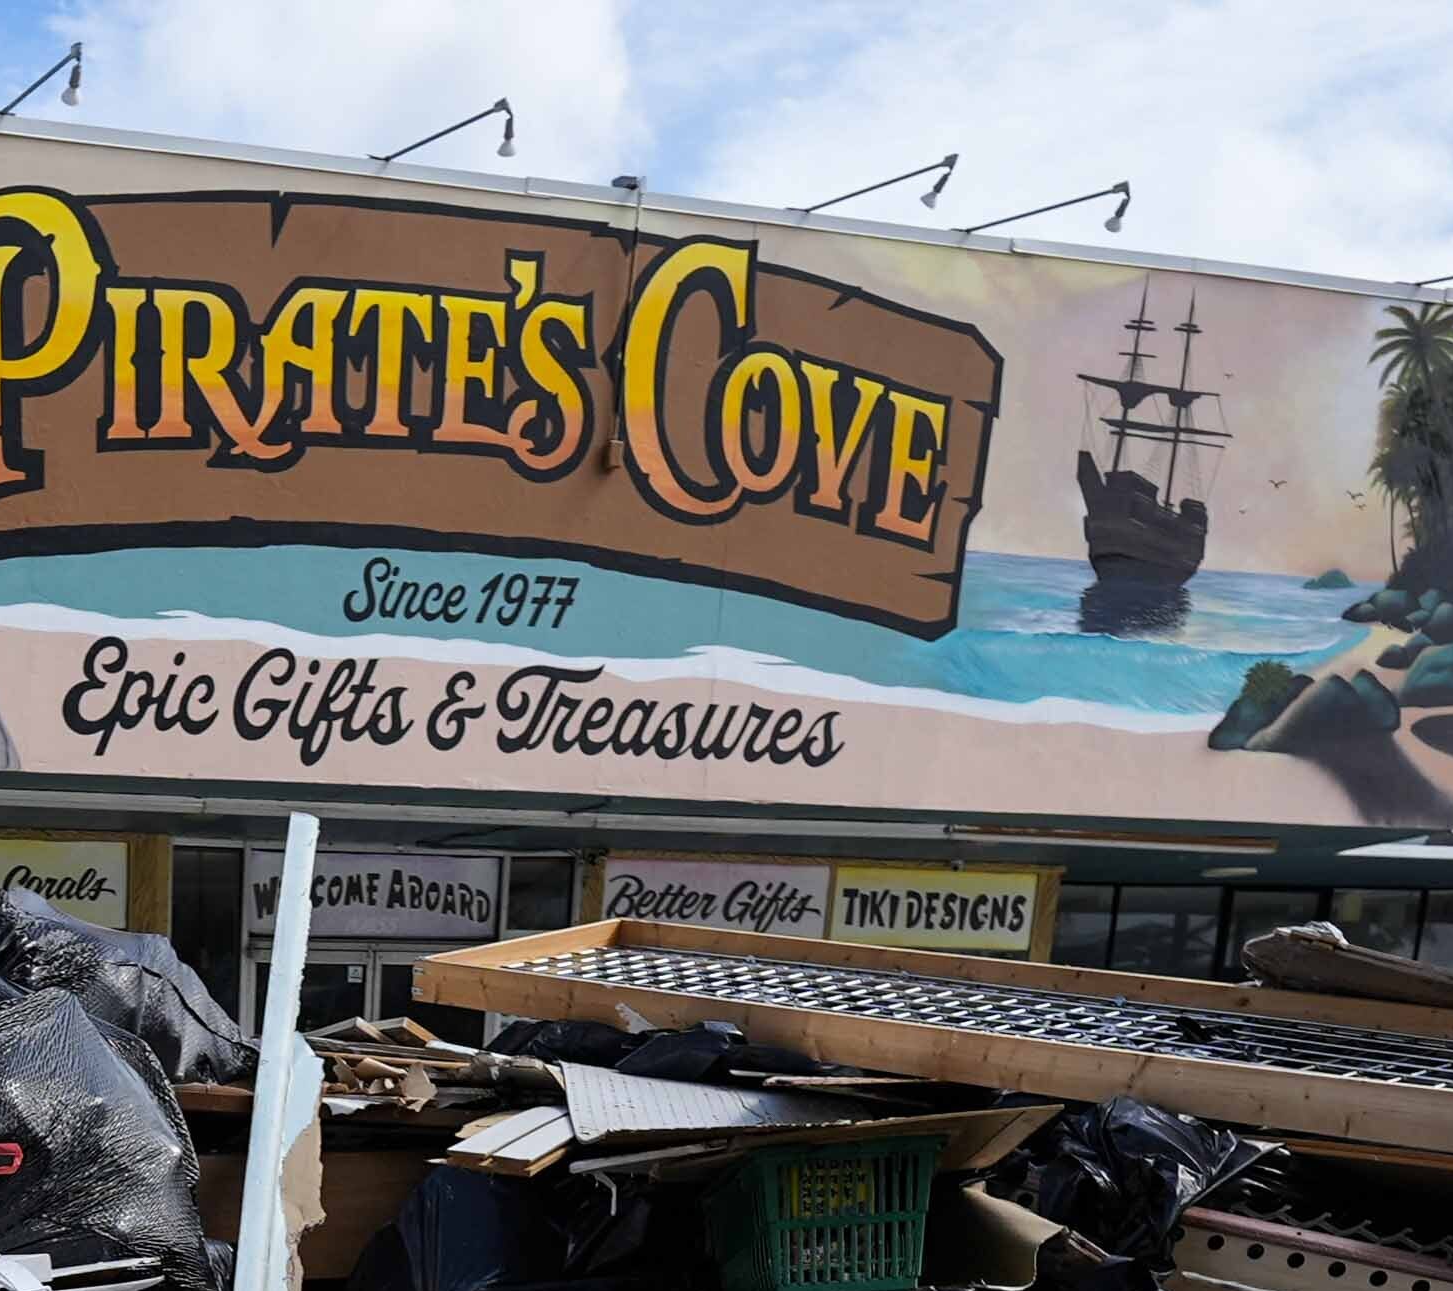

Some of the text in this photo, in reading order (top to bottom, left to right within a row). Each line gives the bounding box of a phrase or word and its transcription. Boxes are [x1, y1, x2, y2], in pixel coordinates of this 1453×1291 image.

[625, 238, 953, 542] COVE
[343, 556, 579, 629] Since 1977
[62, 636, 844, 768] Epic Gifts & Treasures
[253, 869, 492, 924] WCOME ABOARD
[608, 874, 822, 933] Better Gifts
[842, 888, 1027, 933] TIKI DESIGNS
